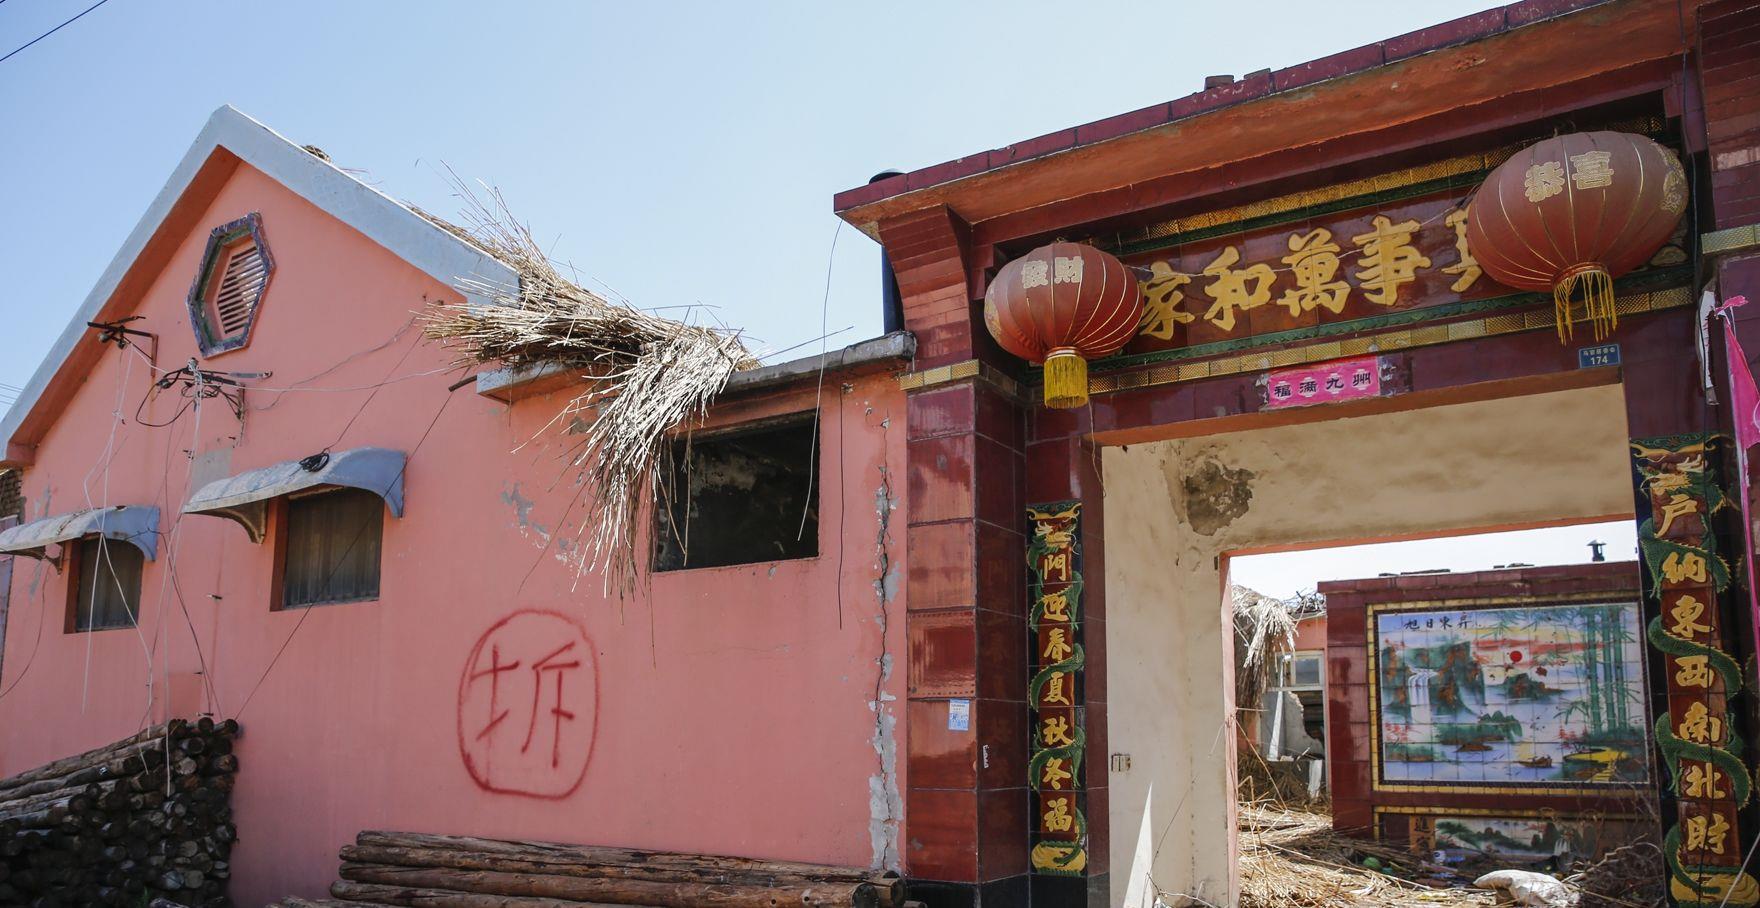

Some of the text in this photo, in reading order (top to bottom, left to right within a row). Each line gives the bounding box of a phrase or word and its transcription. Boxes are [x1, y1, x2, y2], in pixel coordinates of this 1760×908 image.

[1139, 205, 1482, 341] 家和萬事
[1590, 355, 1608, 365] 174
[467, 638, 582, 776] 拆
